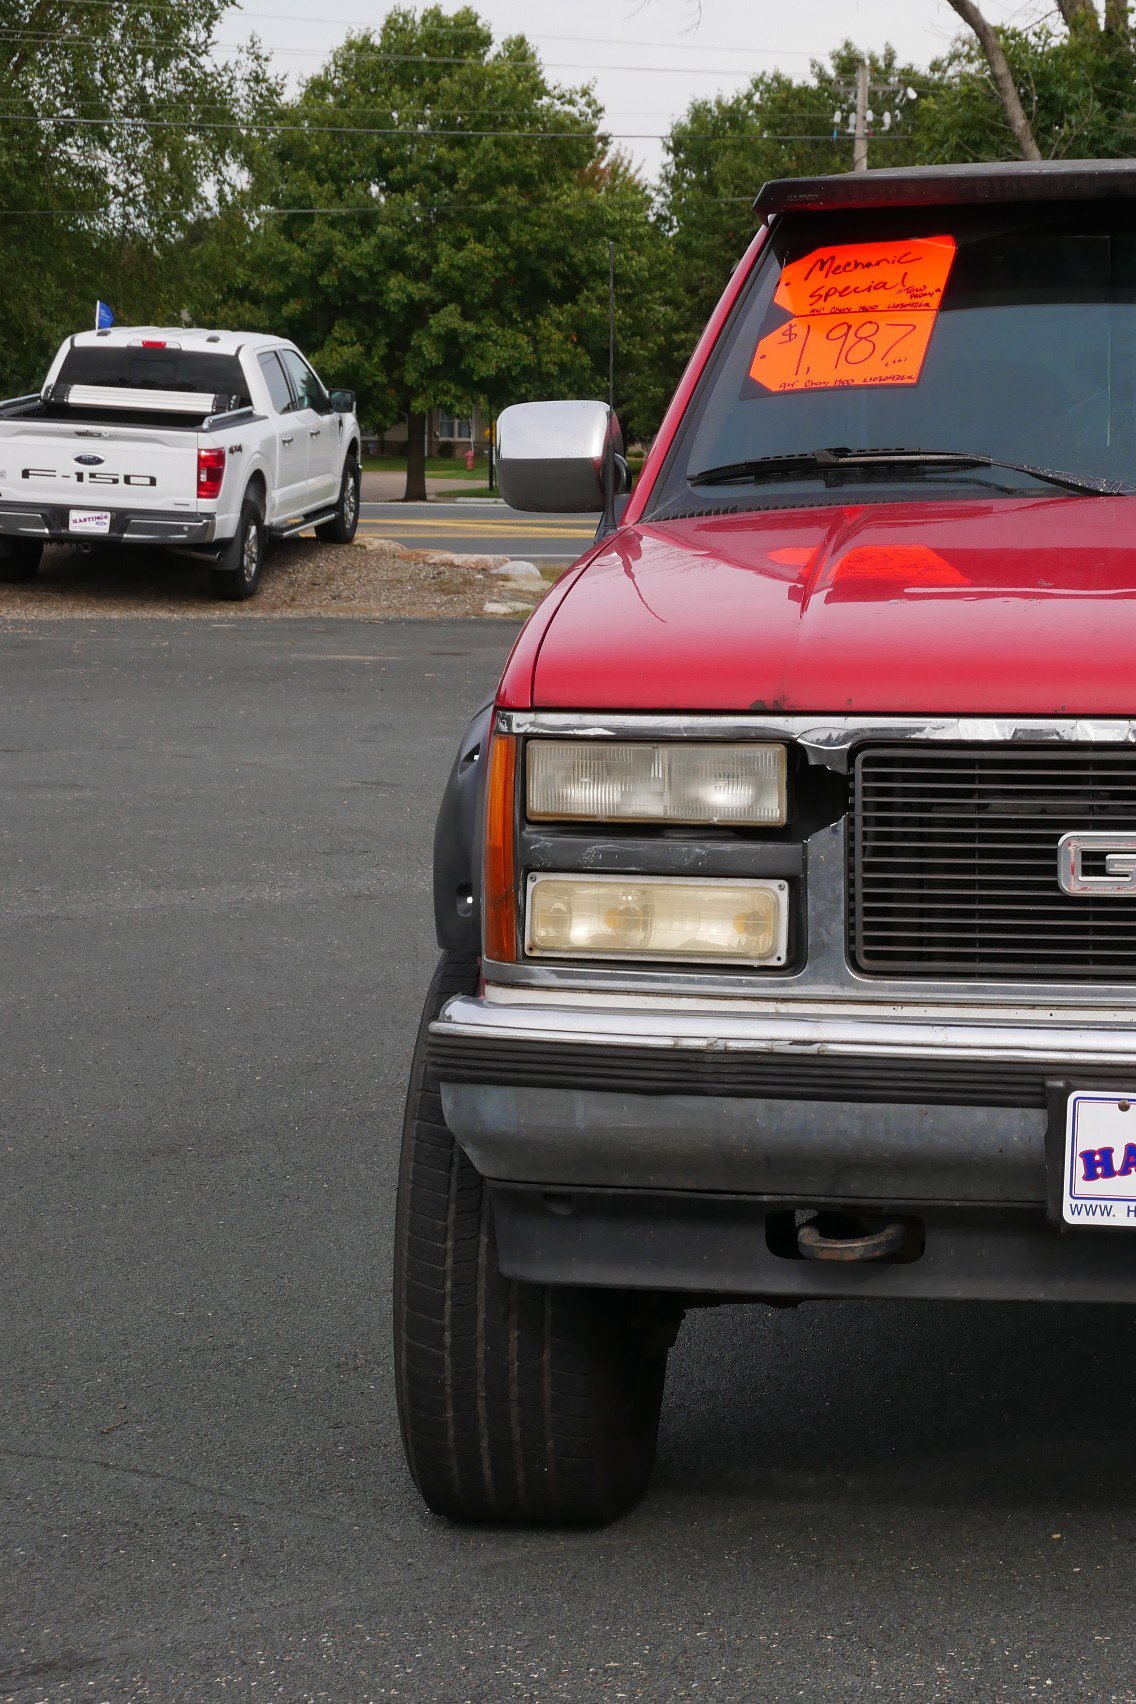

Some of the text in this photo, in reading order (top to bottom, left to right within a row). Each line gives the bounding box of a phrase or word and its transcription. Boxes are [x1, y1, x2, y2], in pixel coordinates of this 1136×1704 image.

[21, 468, 157, 487] F-150
[72, 514, 108, 525] HASTINGS
[1069, 1203, 1116, 1218] WWW.
